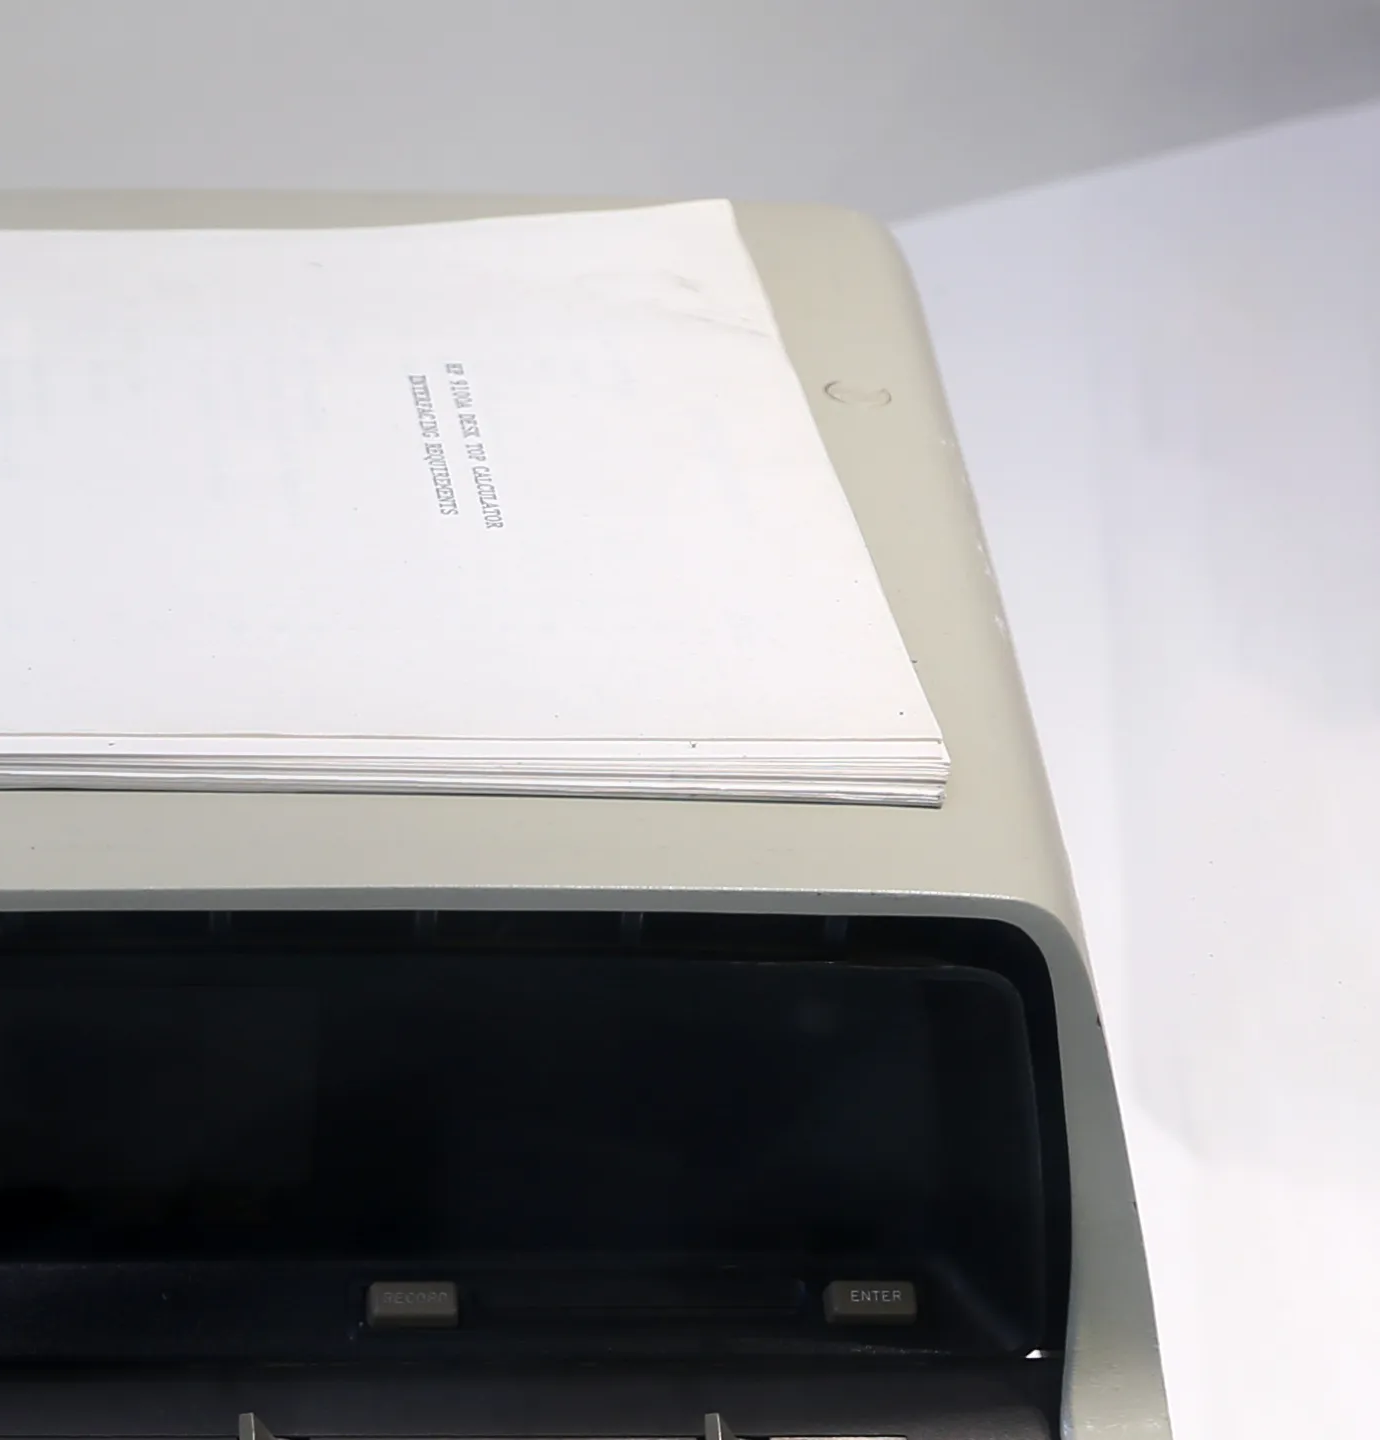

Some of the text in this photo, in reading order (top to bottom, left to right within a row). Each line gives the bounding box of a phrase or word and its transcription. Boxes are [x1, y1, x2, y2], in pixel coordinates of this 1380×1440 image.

[458, 414, 480, 438] DESK
[465, 443, 486, 461] TOP
[423, 443, 459, 515] REQUIREMENTS
[472, 466, 503, 529] CALCULATOR
[851, 1290, 902, 1302] ENTER
